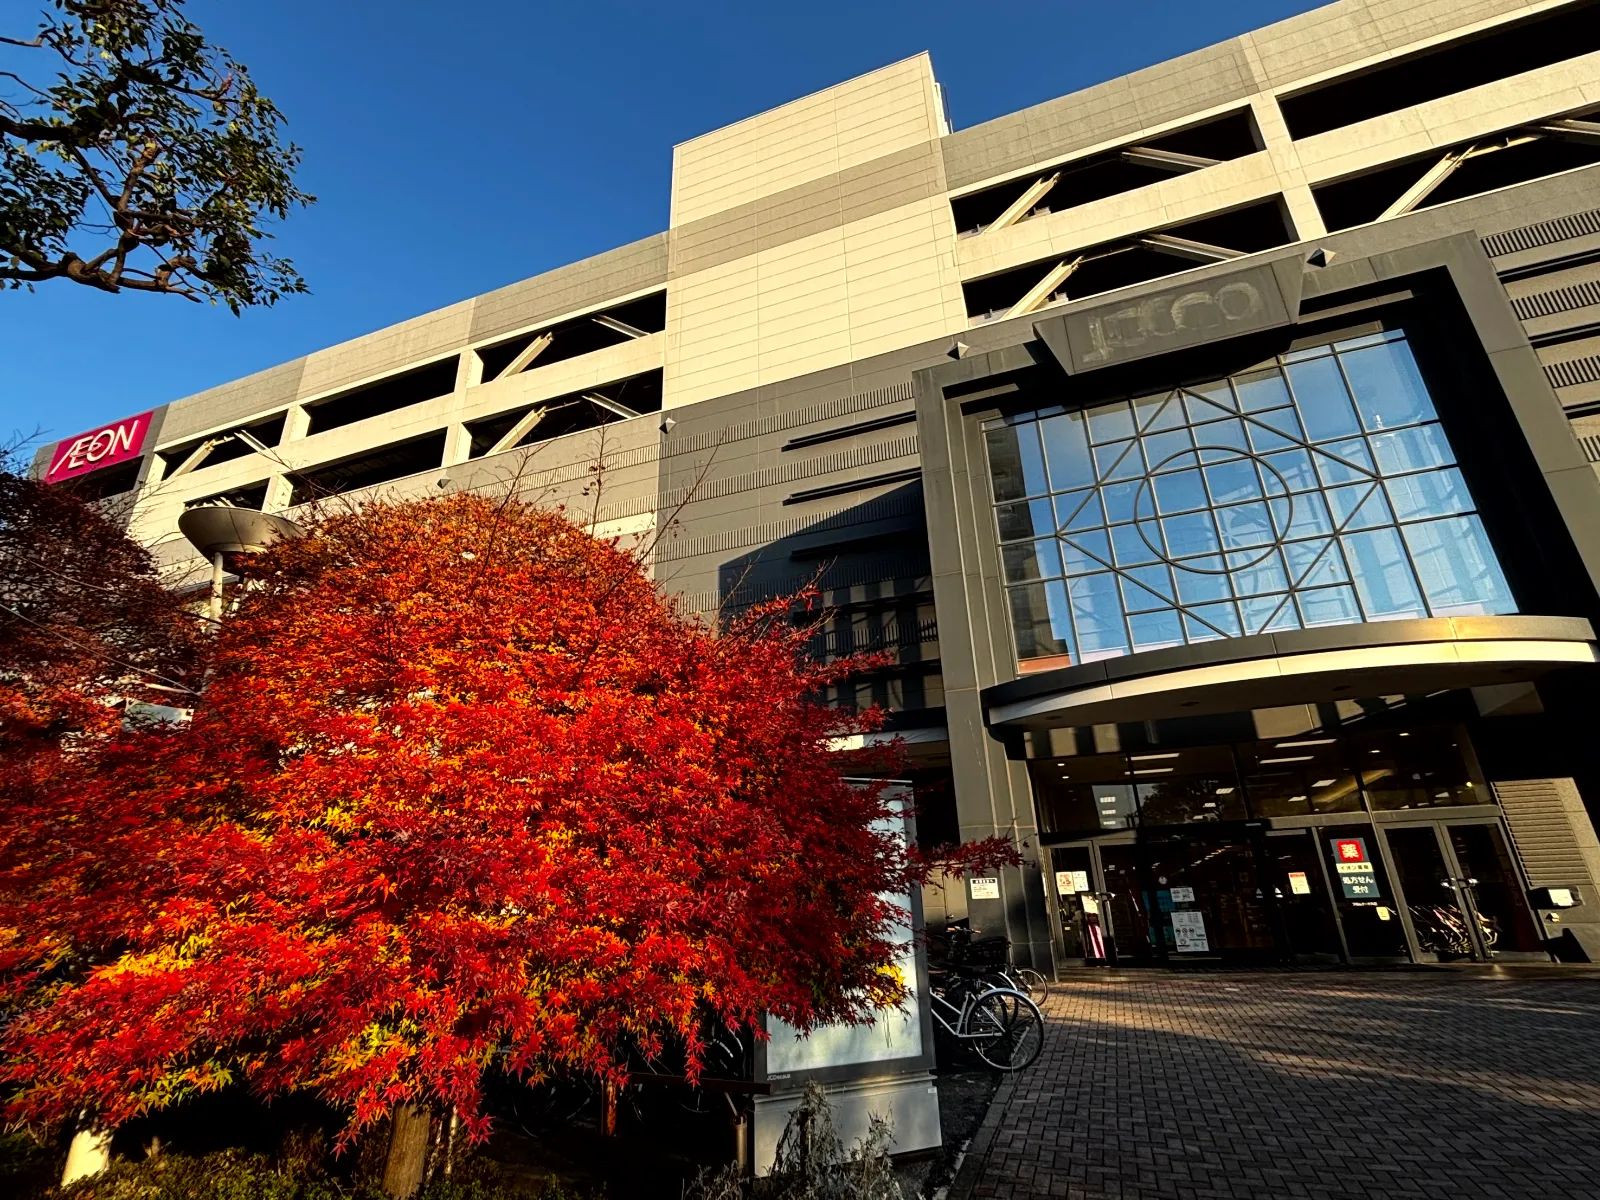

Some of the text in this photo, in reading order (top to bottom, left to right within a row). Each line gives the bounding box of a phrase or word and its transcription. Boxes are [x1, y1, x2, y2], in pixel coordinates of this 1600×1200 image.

[1340, 843, 1359, 859] 薬
[1342, 876, 1374, 885] 処方せん
[1352, 885, 1369, 894] 受付
